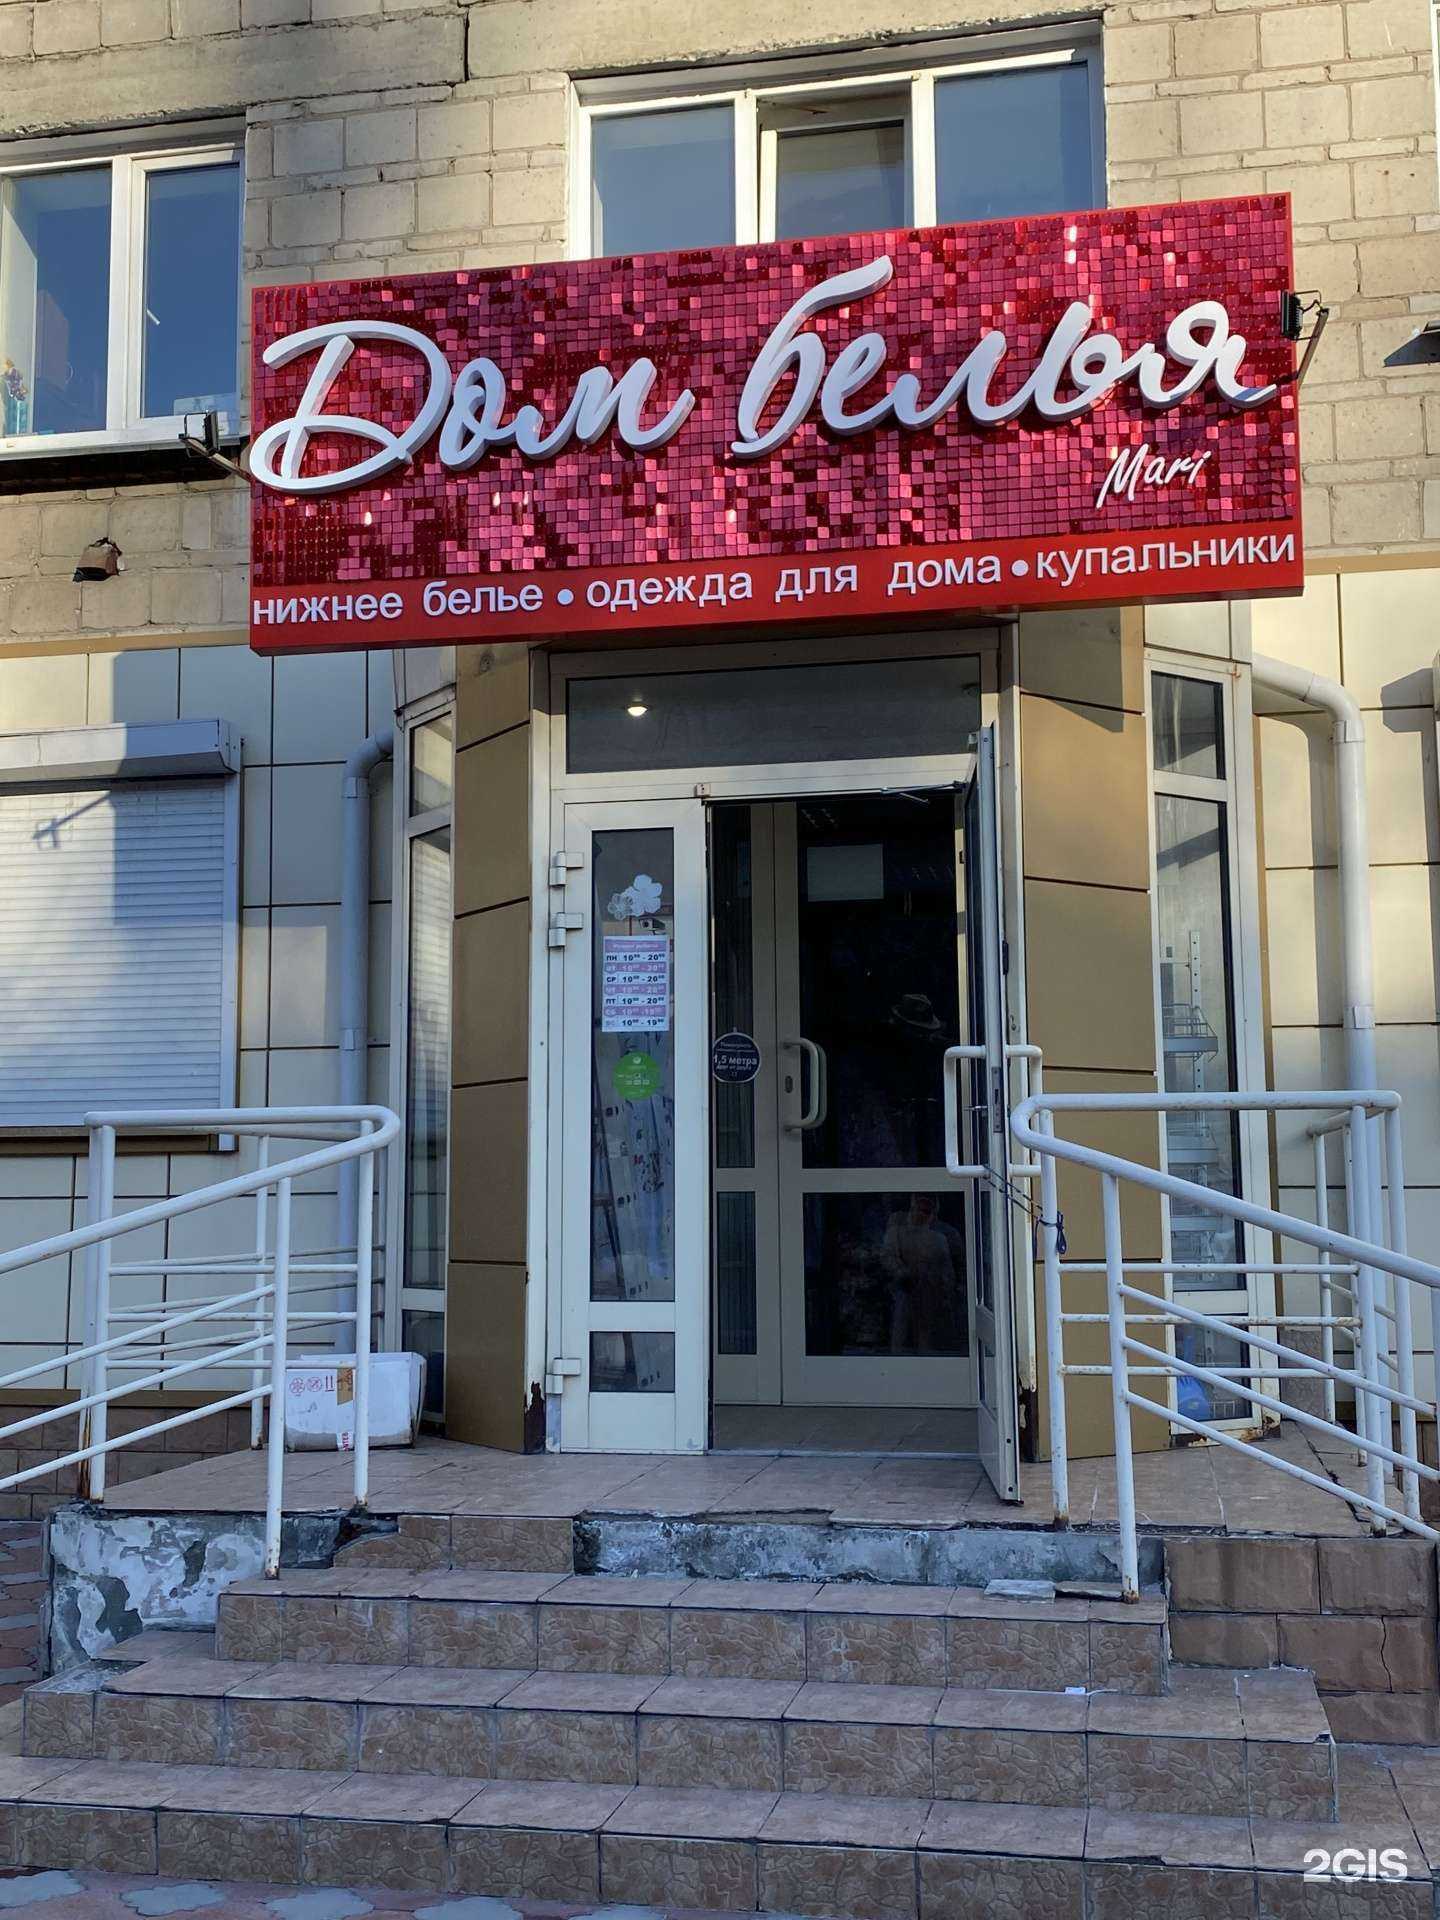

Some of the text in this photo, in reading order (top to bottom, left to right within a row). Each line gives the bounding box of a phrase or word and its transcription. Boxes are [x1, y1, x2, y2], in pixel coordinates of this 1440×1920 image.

[249, 255, 1277, 495] Дом белья
[1096, 443, 1212, 509] Mari
[253, 532, 1296, 625] нижнее белье одежда для дома купальники
